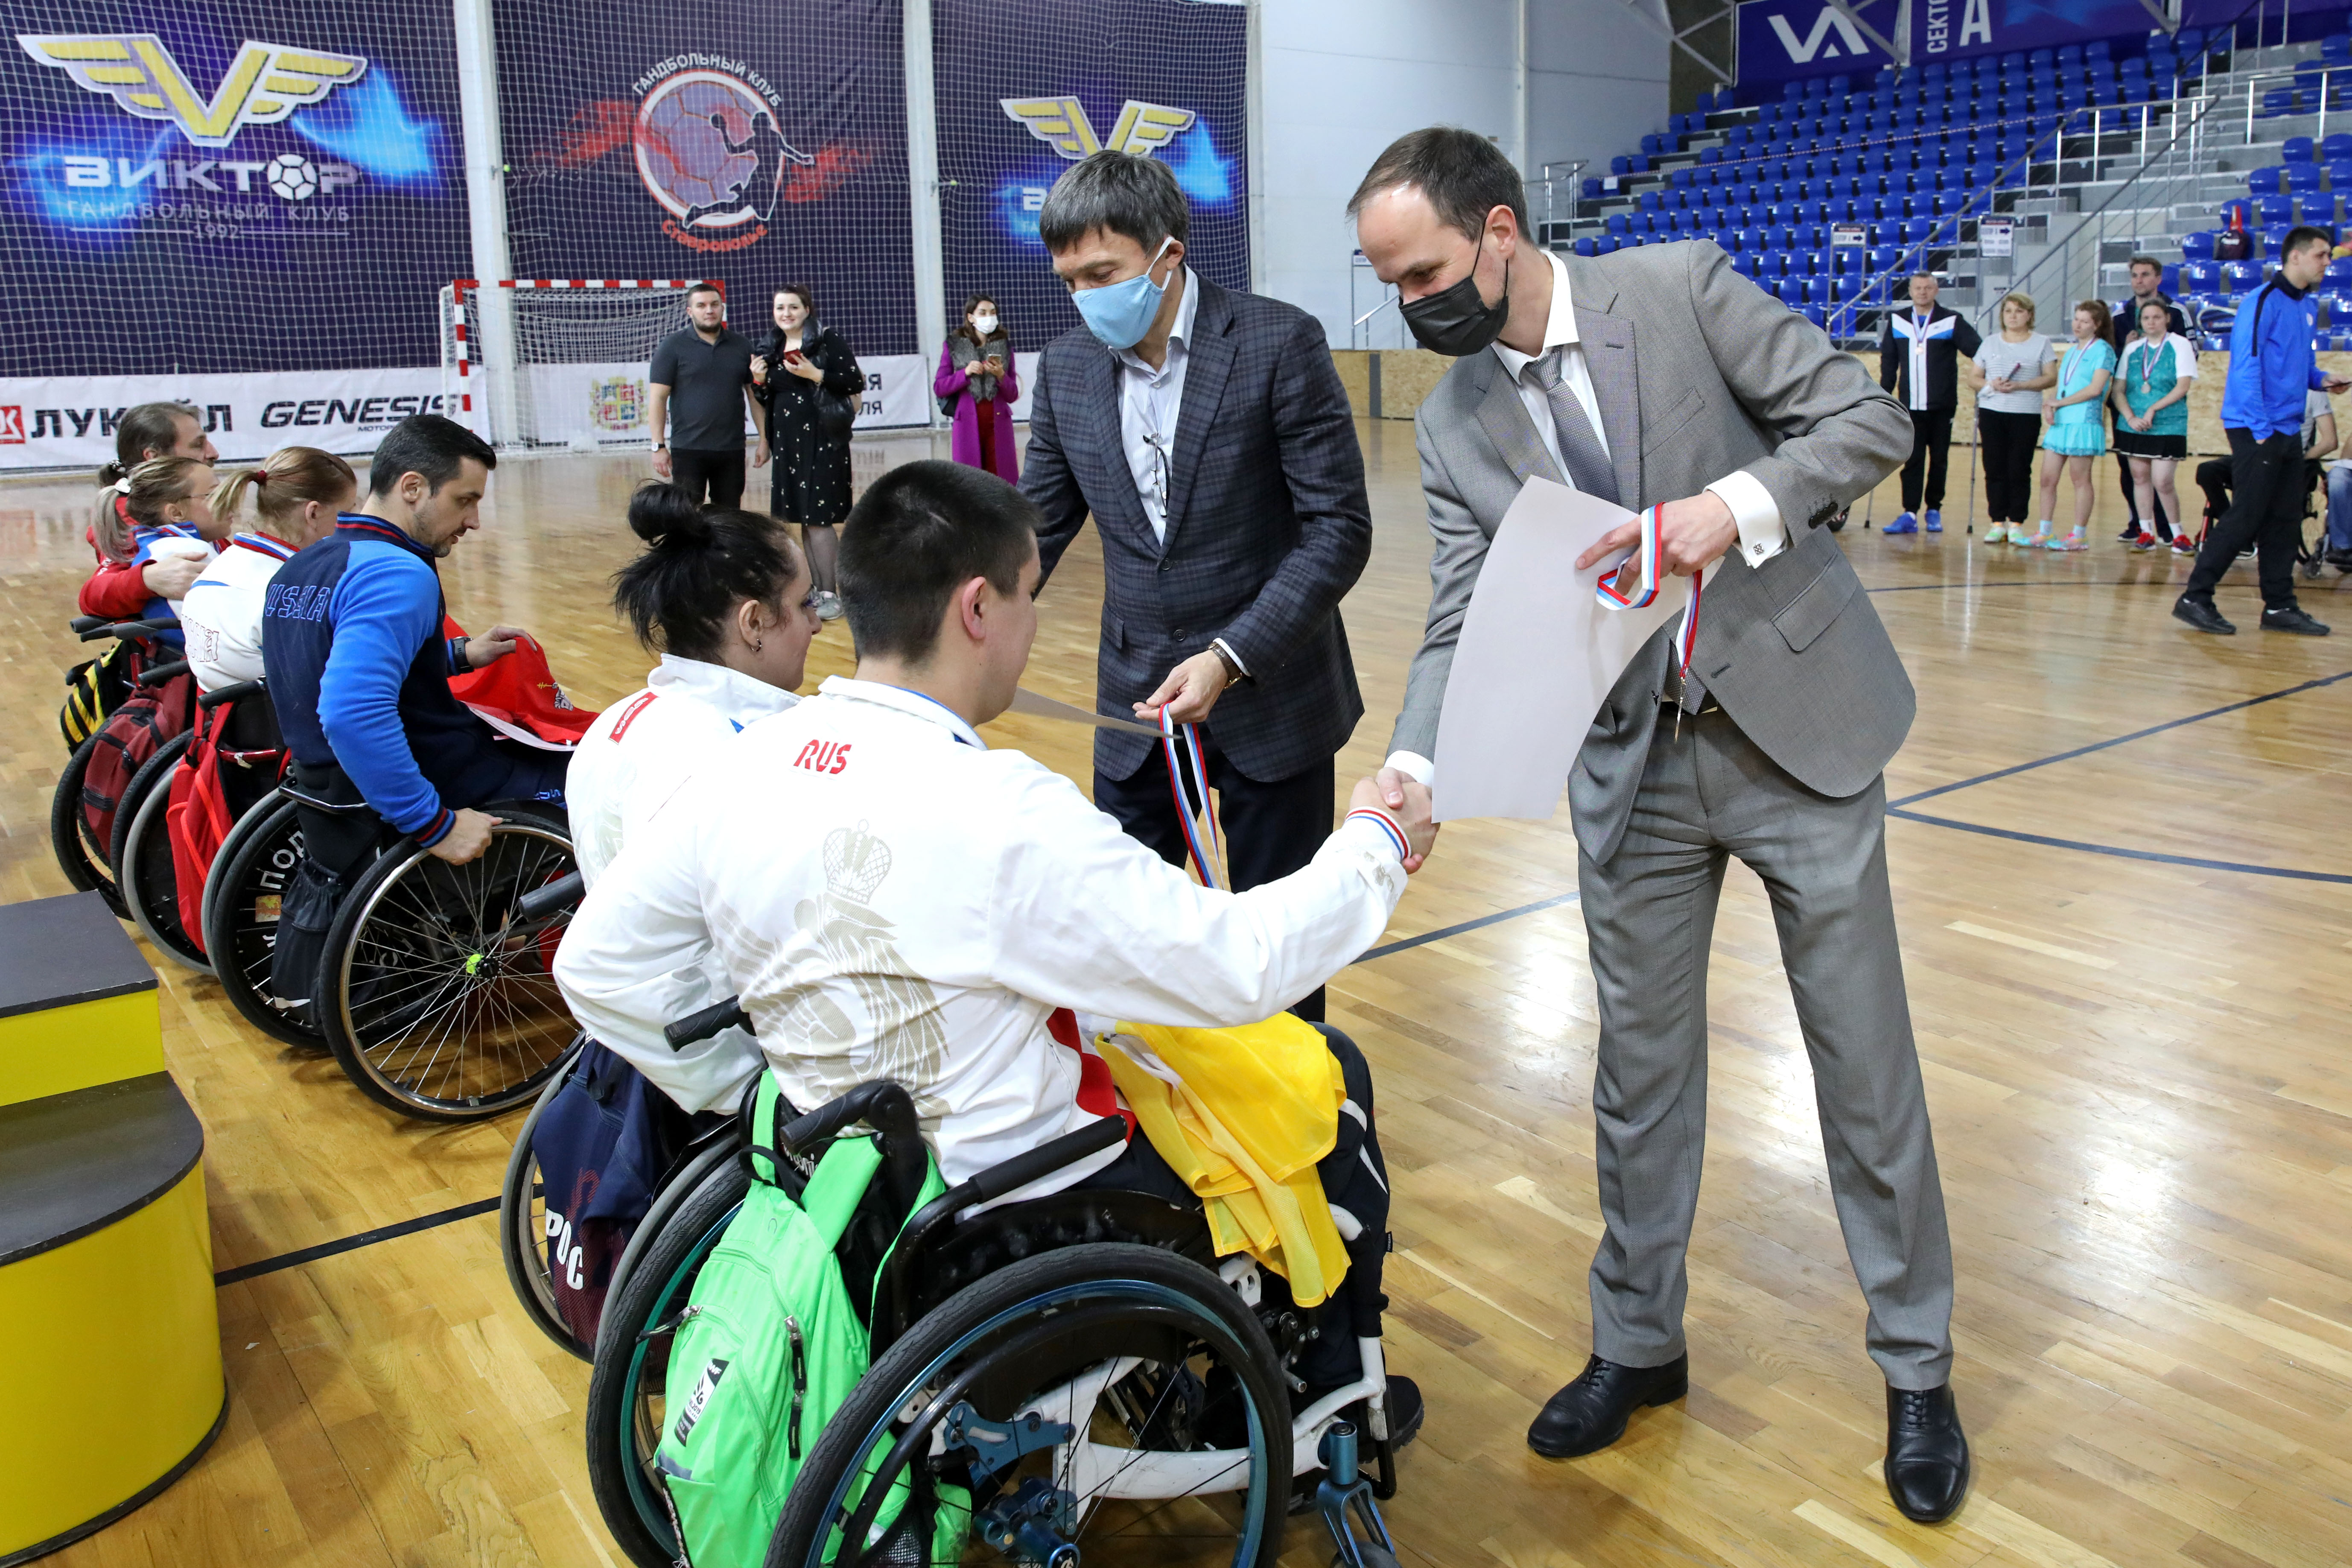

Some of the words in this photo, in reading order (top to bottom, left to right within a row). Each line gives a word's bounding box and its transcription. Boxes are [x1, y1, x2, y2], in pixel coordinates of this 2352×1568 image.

[633, 53, 746, 95] ГАНДБОЛЬНЫЙ
[748, 70, 782, 107] КЛУБ
[64, 154, 358, 200] ВИКТОР
[67, 200, 271, 221] ГАНДБОЛЬНЫЙ
[288, 205, 350, 222] КЛУБ
[193, 223, 238, 239] 1992
[662, 219, 768, 253] Ставрополье
[31, 398, 233, 438] ЛУКЛ
[793, 739, 852, 775] RUS
